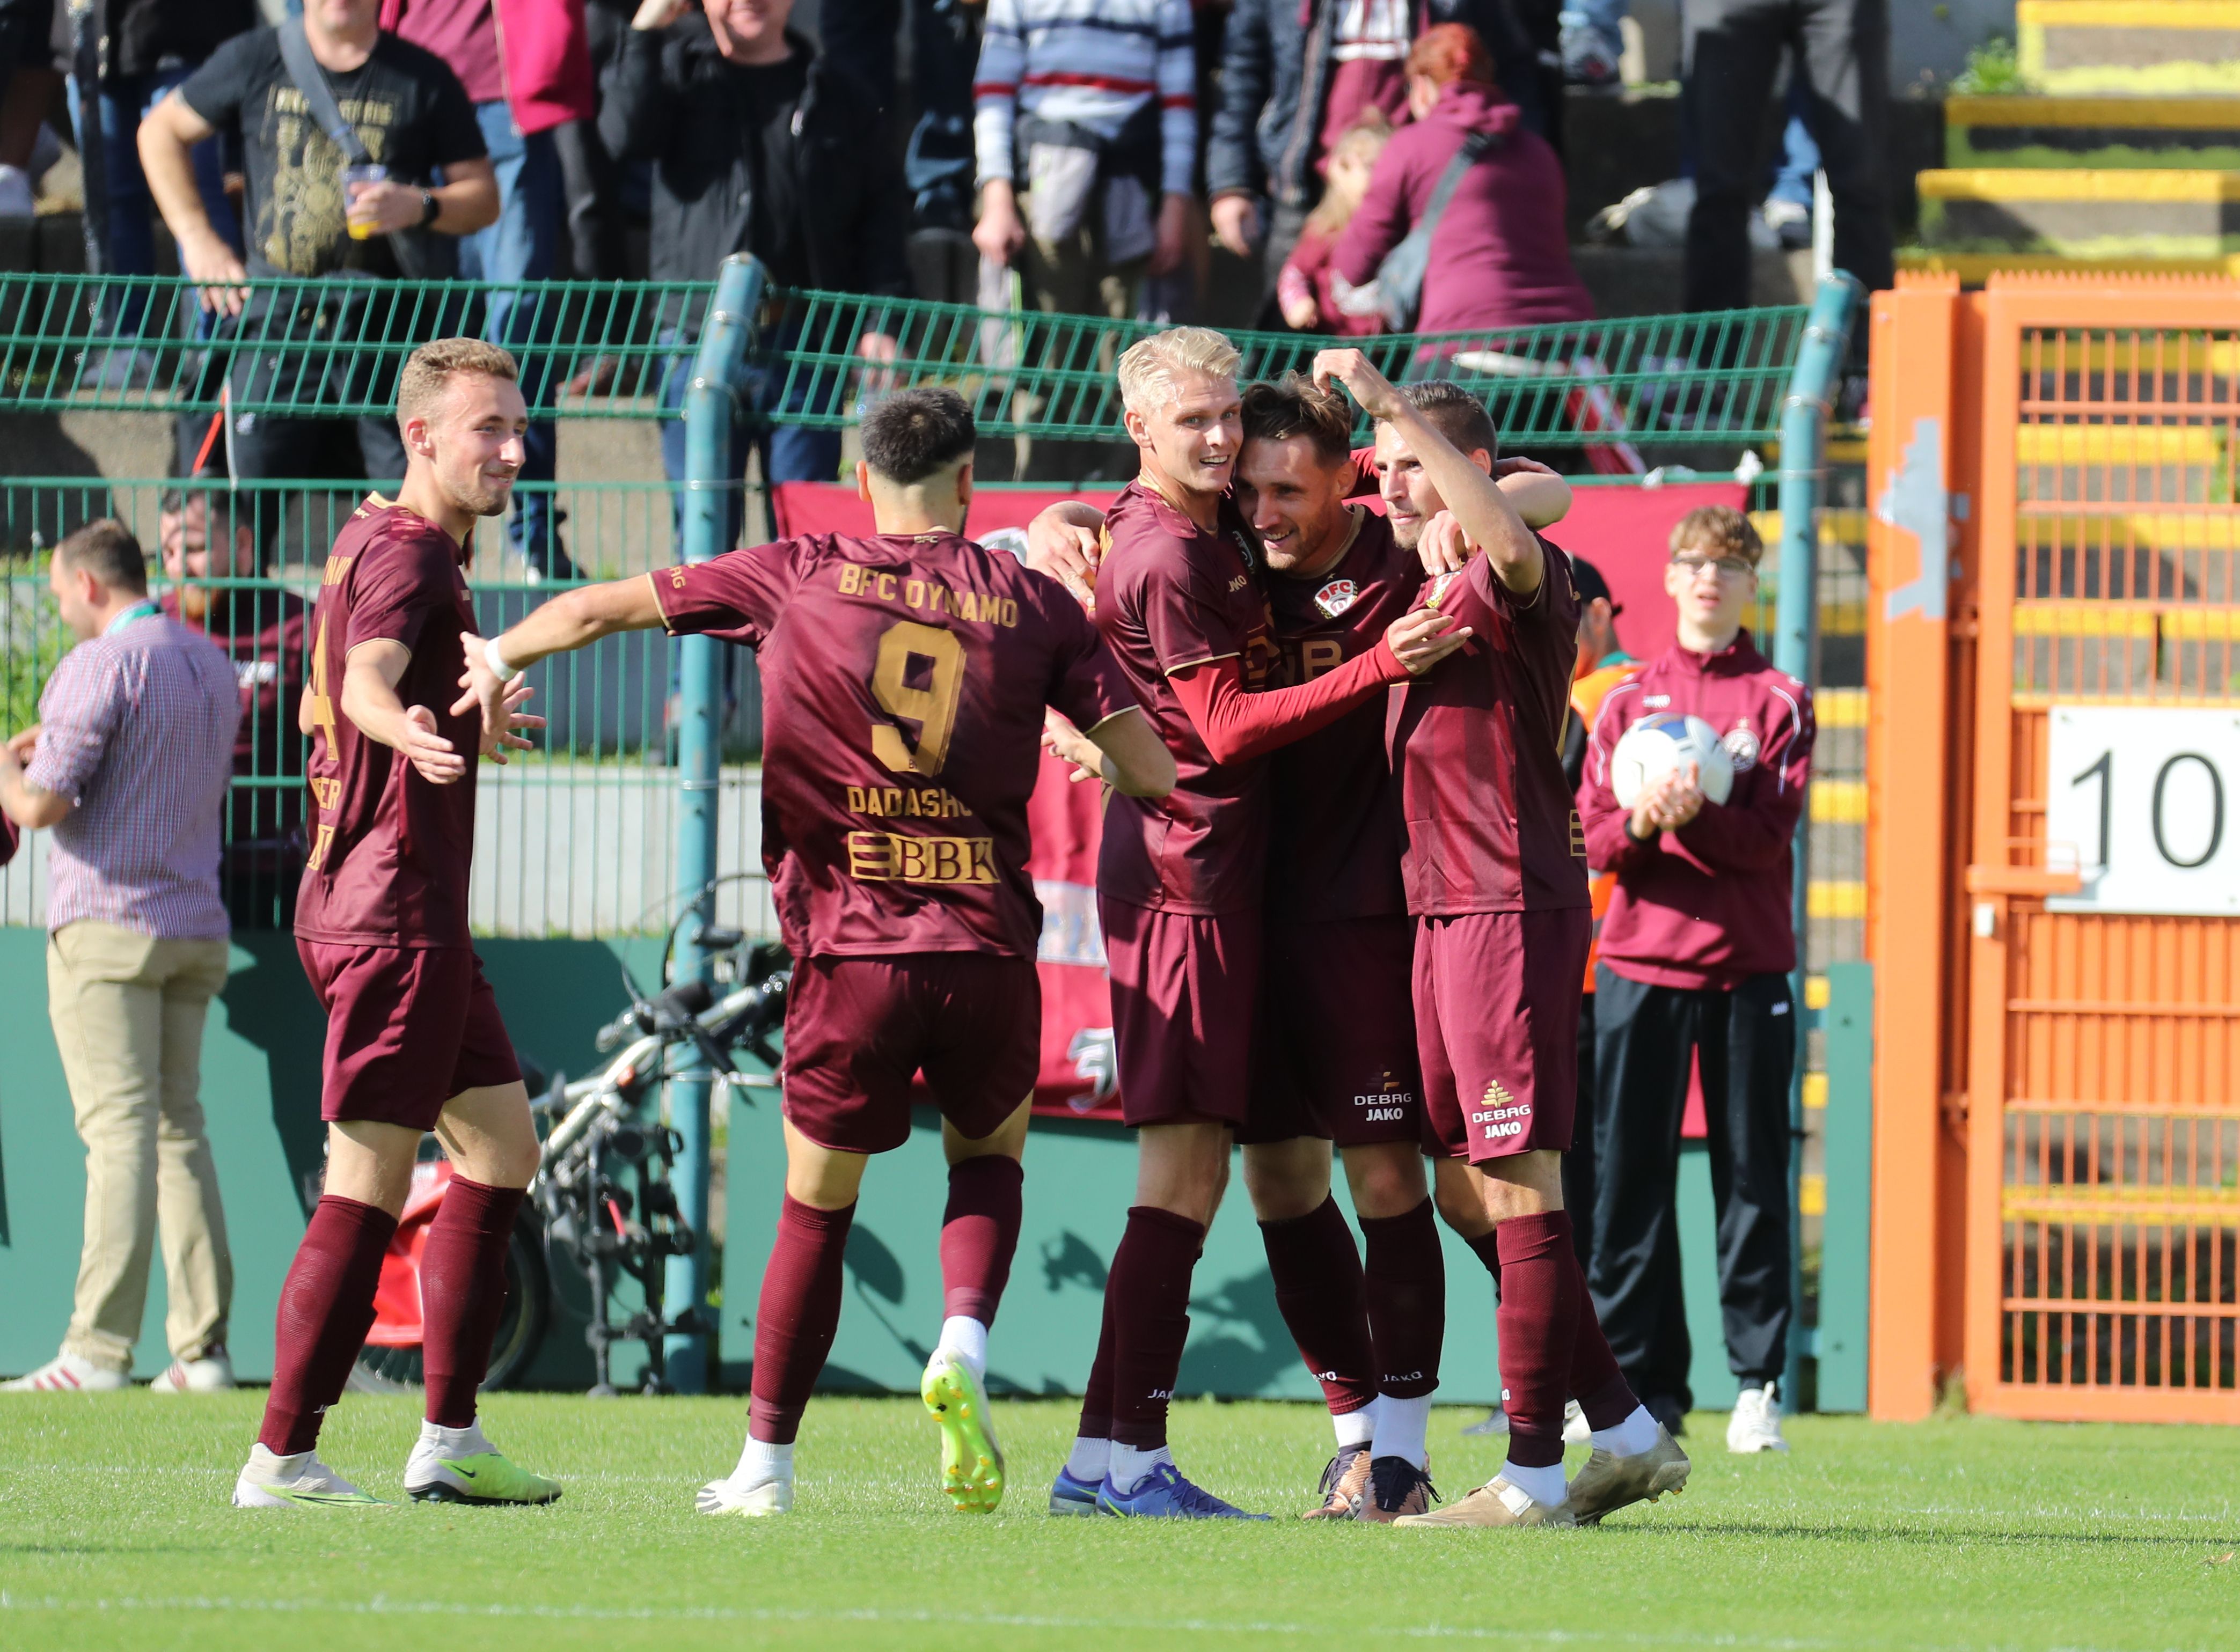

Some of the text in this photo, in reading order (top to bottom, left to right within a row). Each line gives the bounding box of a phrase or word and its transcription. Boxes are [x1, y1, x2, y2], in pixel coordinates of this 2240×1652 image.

[838, 563, 1018, 628] BFC DYNAMO
[1319, 582, 1351, 603] BFC
[871, 620, 966, 777] 9
[2072, 748, 2224, 868] 10
[896, 838, 999, 880] BBK
[1355, 1093, 1411, 1106] DEBAG
[1366, 1107, 1403, 1121] JAKO
[1472, 1104, 1531, 1124] DEBAG
[1484, 1122, 1521, 1139] JAKO
[1383, 1371, 1423, 1382] JAKO
[1148, 1389, 1174, 1399] JAK
